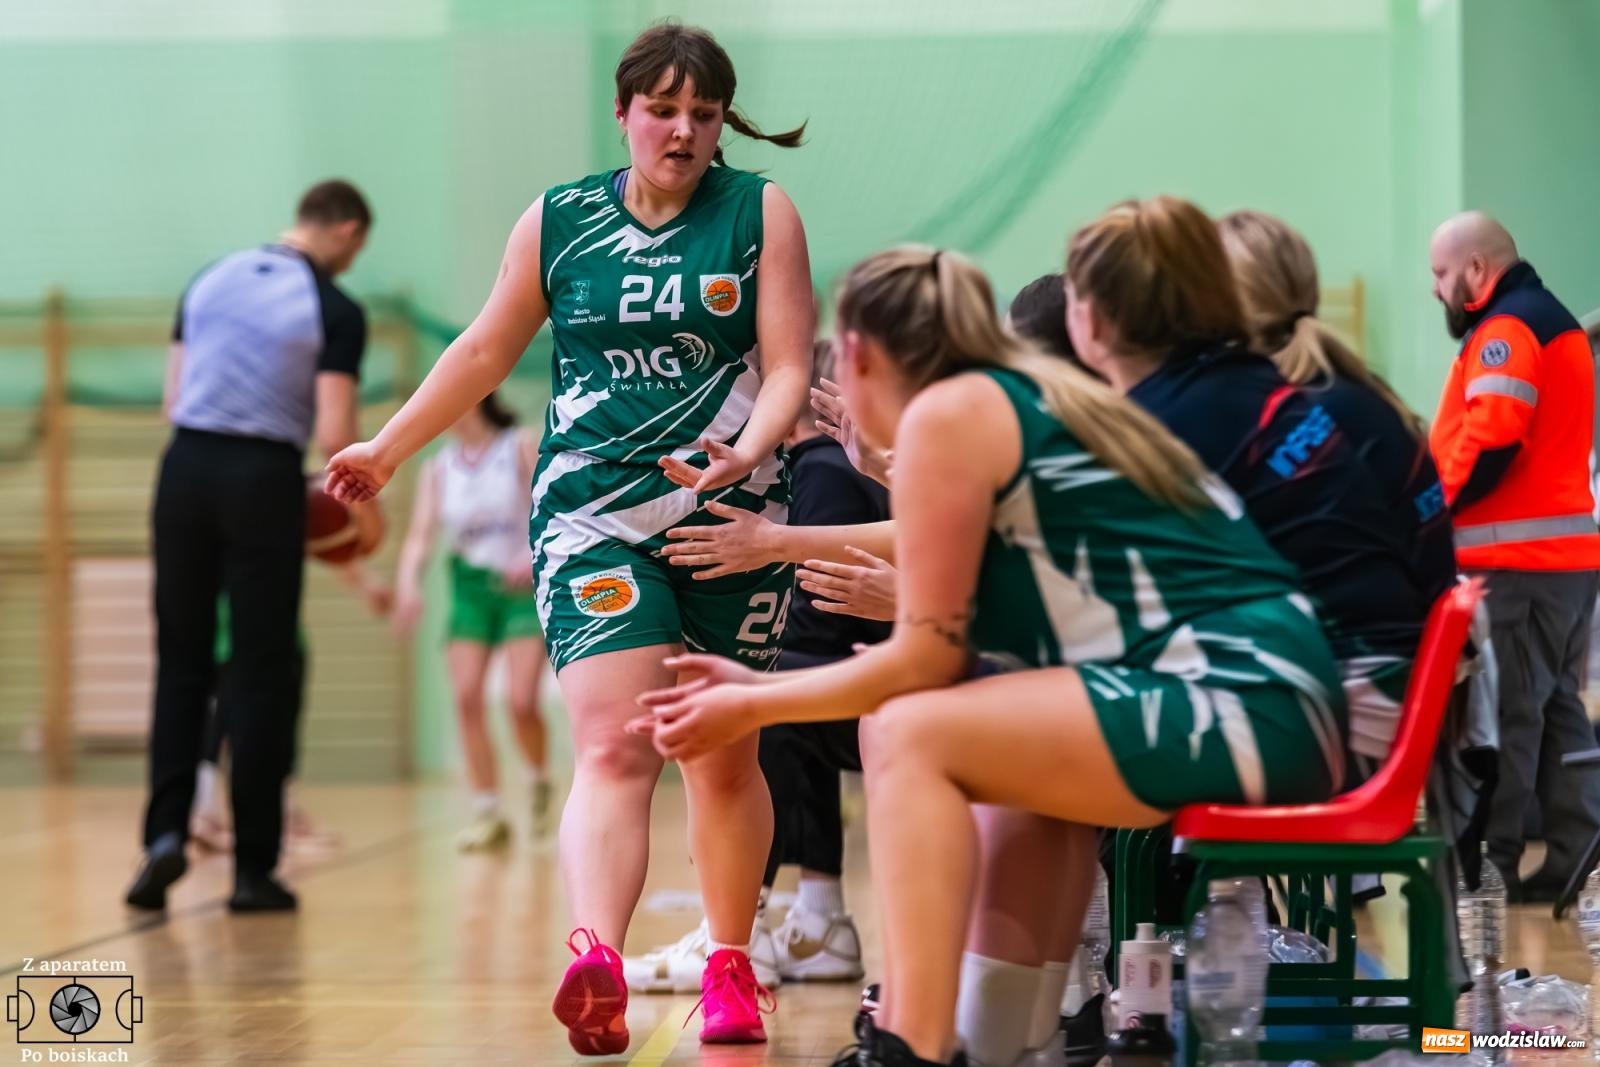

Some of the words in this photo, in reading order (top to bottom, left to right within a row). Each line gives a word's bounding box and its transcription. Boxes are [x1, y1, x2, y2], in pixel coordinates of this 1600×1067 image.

[622, 254, 683, 268] regio
[618, 273, 685, 323] 24
[704, 292, 729, 303] OLIMPIA
[603, 346, 682, 379] DIG
[610, 380, 688, 392] ŚWITAŁA
[580, 588, 617, 607] OLIMPIA
